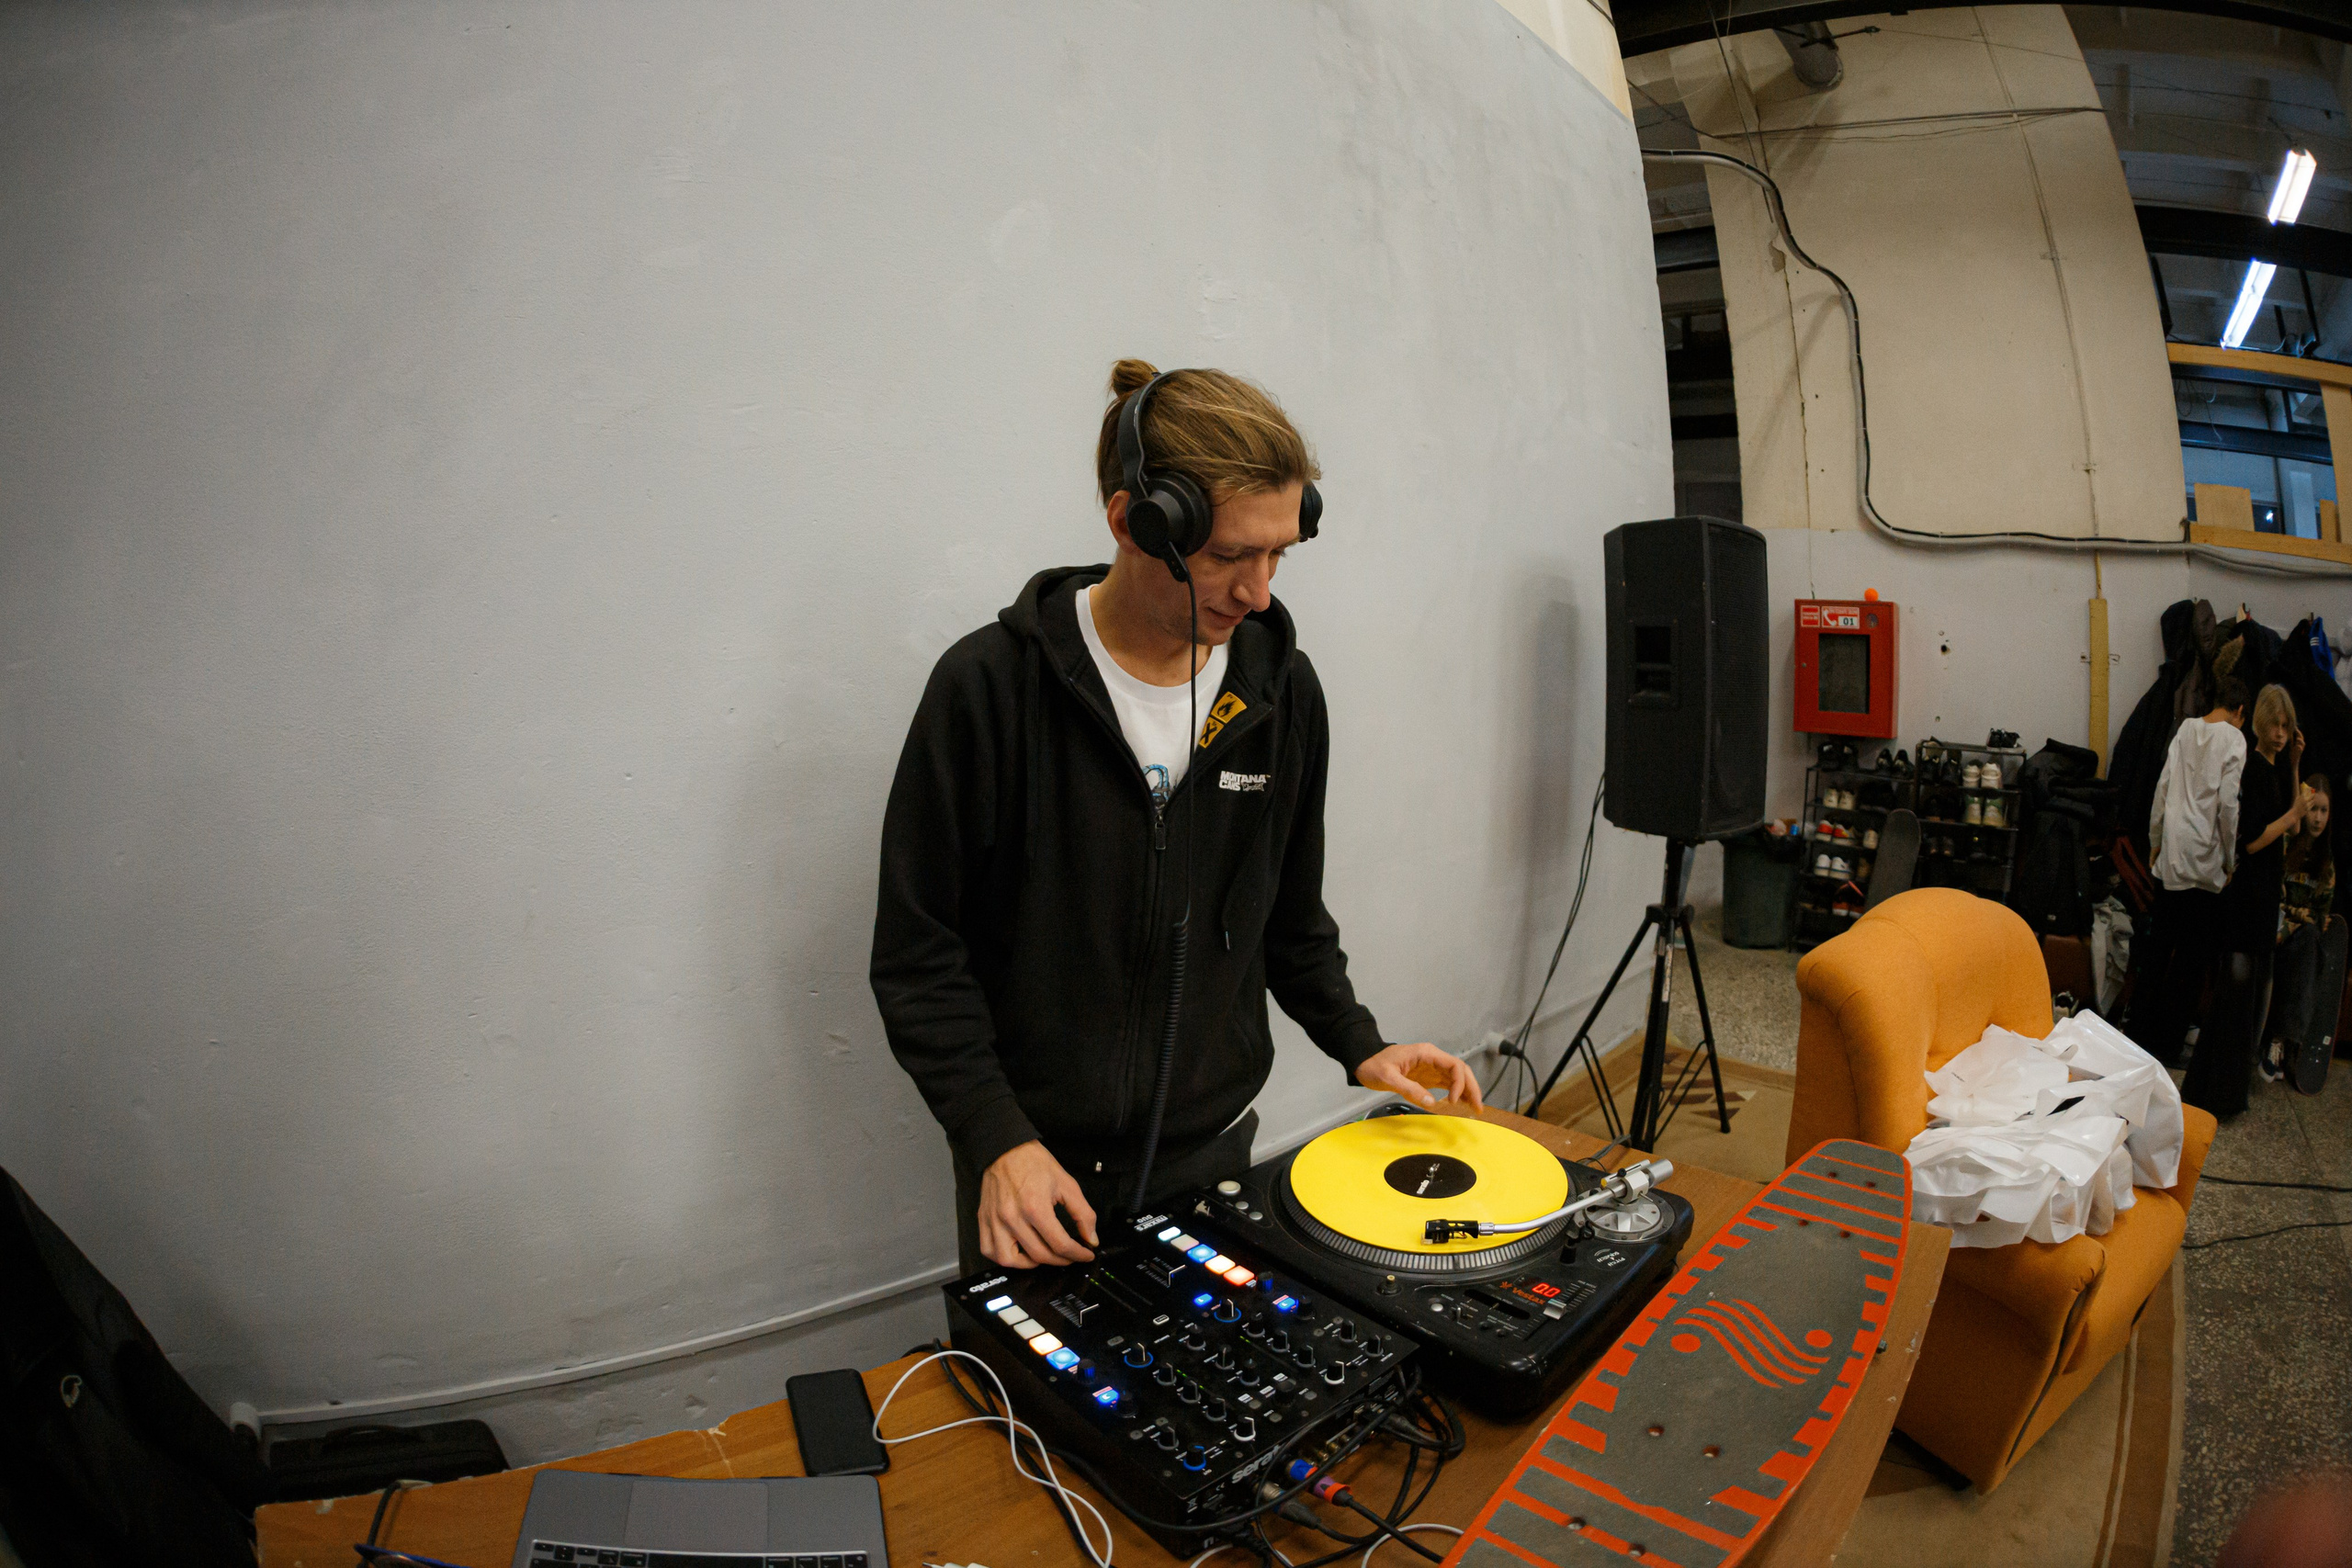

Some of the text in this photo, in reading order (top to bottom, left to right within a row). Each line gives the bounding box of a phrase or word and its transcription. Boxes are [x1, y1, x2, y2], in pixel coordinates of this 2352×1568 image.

[1843, 617, 1854, 626] 01
[968, 1275, 1008, 1293] serato
[1511, 1287, 1546, 1305] Vestax
[1231, 1444, 1285, 1484] serat
